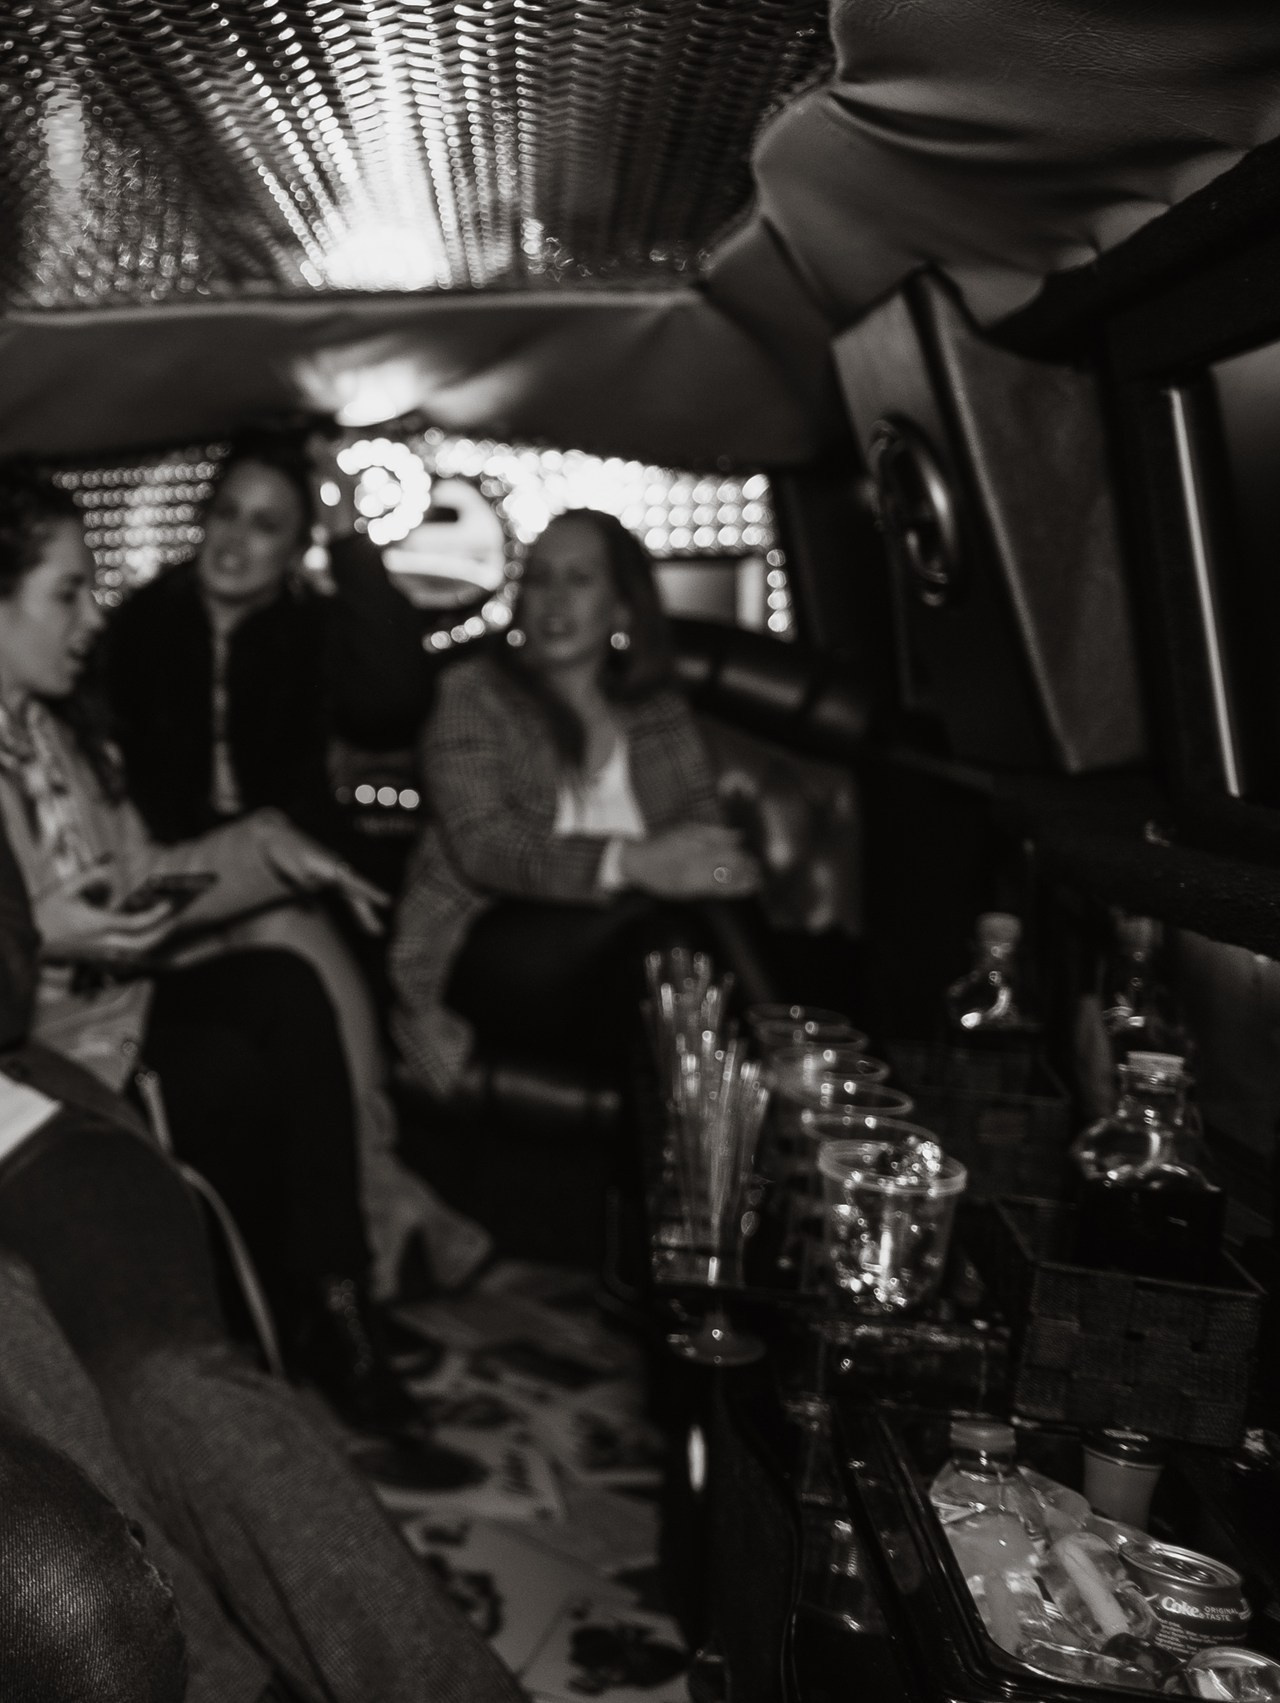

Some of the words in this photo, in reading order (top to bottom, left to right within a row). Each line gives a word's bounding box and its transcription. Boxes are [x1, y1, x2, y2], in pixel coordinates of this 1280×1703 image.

[1161, 1596, 1200, 1618] Coke
[1203, 1605, 1239, 1615] ORIGINAL
[1205, 1612, 1232, 1622] TASTE
